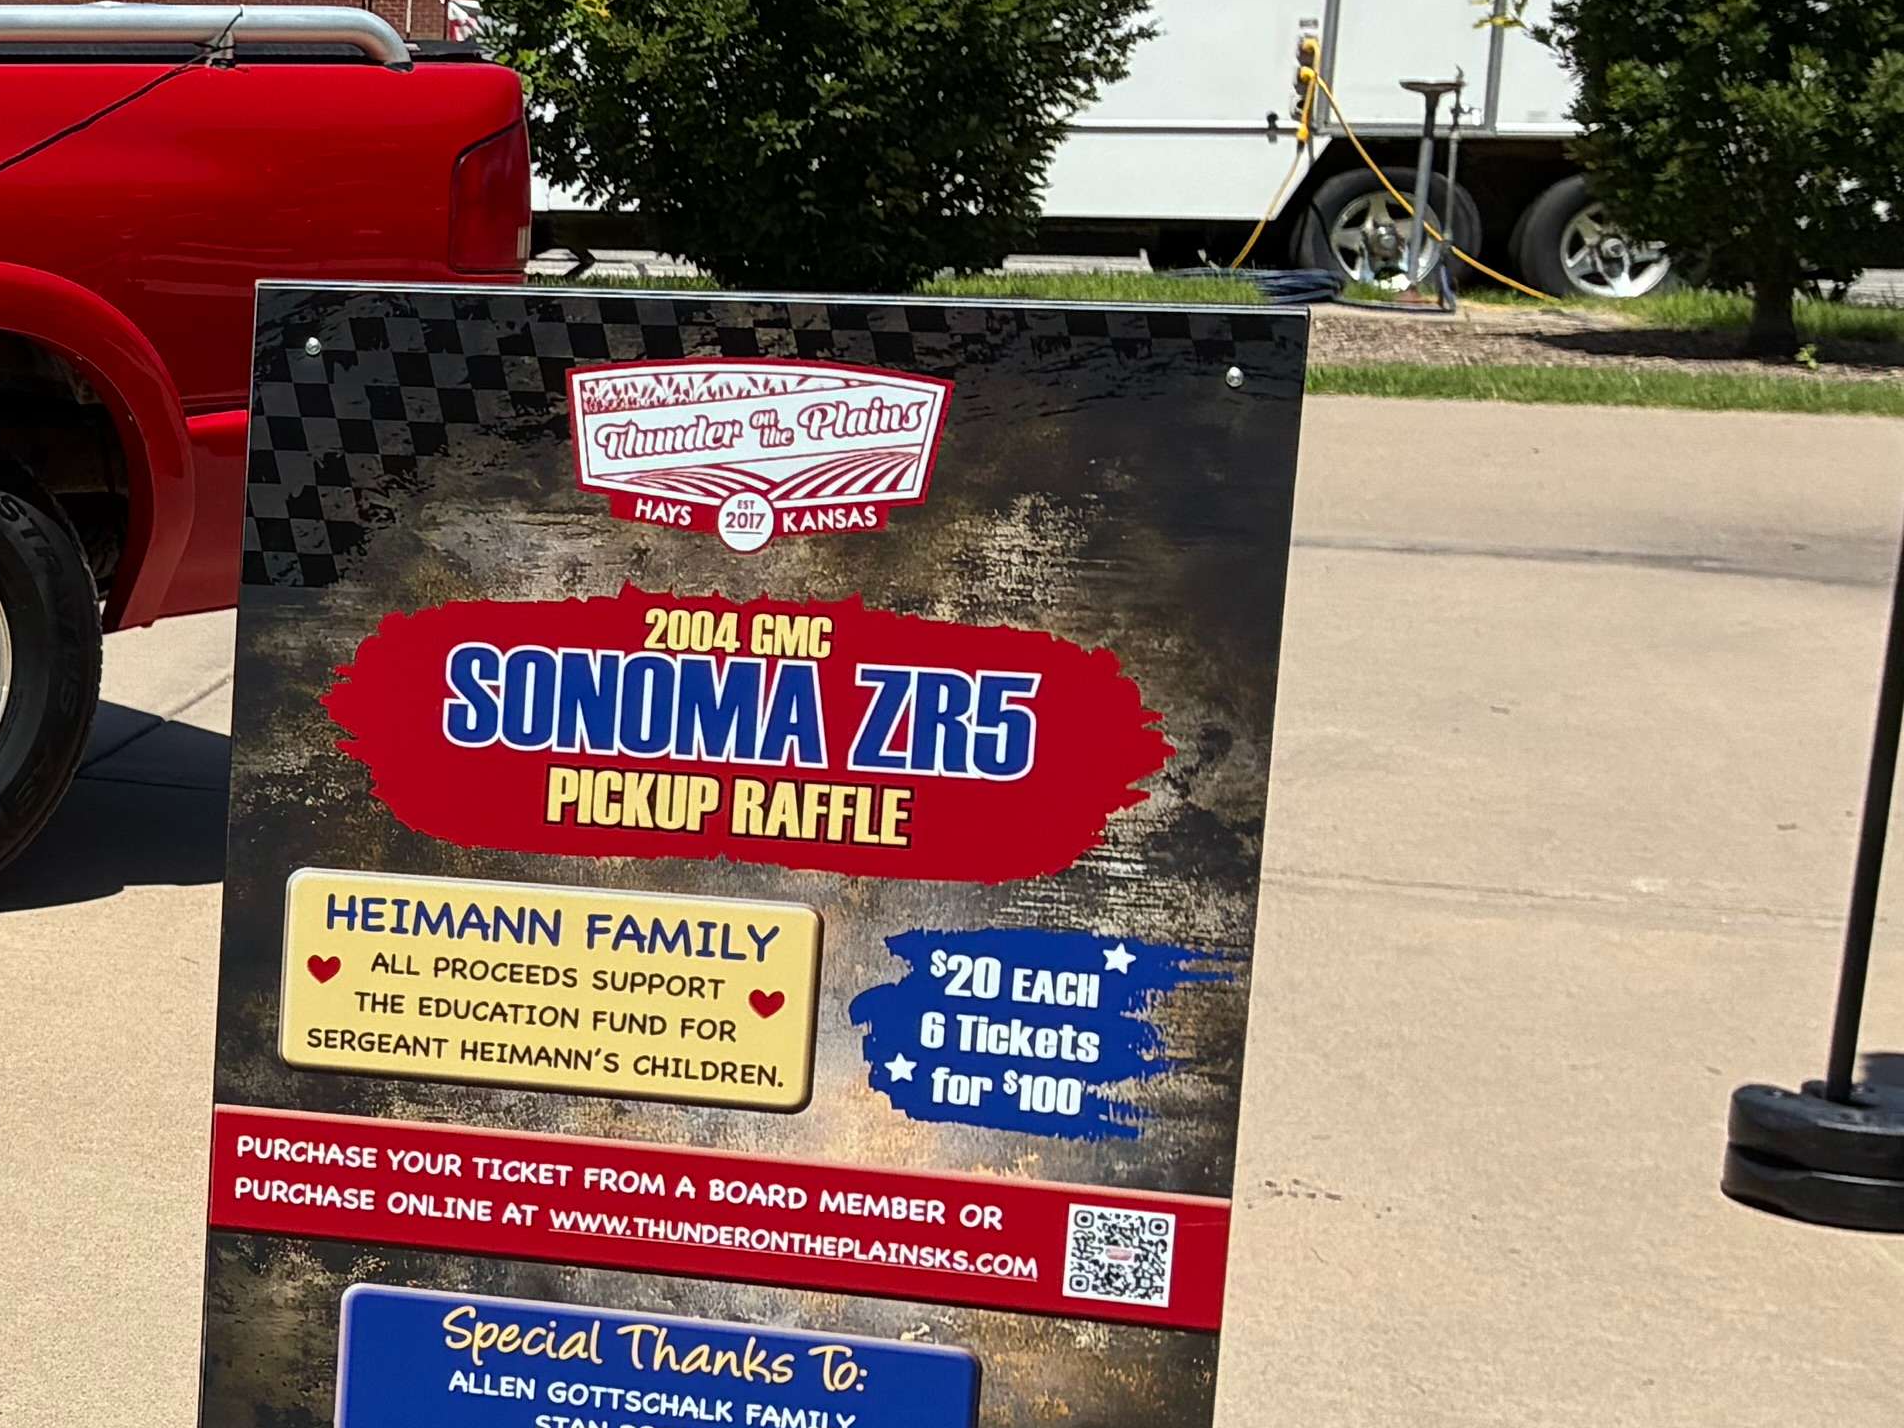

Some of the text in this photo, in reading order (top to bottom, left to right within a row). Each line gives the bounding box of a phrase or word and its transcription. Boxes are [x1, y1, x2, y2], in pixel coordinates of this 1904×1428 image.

[595, 397, 929, 460] Thunder on the Plains
[634, 499, 692, 526] HAYS
[723, 511, 765, 529] 2017
[737, 499, 755, 509] EST
[782, 505, 878, 533] KANSAS
[644, 608, 833, 659] 2004 GMC
[443, 642, 1042, 781] SONOMA ZR5
[546, 767, 912, 847] PICKUP RAFFLE
[327, 893, 780, 962] HEIMANN FAMILY
[370, 952, 726, 1000] ALL PROCEEDS SUPPORT
[930, 949, 1100, 1008] $20 EACH
[354, 990, 737, 1043] THE EDUCATION FUND FOR
[920, 1011, 1100, 1064] 6 Tickets
[306, 1027, 785, 1088] SERGEANT HEIMANN'S CHILDREN.
[931, 1067, 1082, 1116] for $100
[237, 1135, 1003, 1231] PURCHASE YOUR TICKET FROM A BOARD MEMBER OR
[234, 1177, 1039, 1282] PURCHASE ONLINE AT WWW.THUNDERONTHEPLAINSKS.COM
[442, 1305, 869, 1392] Special Thanks To:
[448, 1369, 536, 1401] ALLEN
[547, 1381, 734, 1424] GOTTSCHALK
